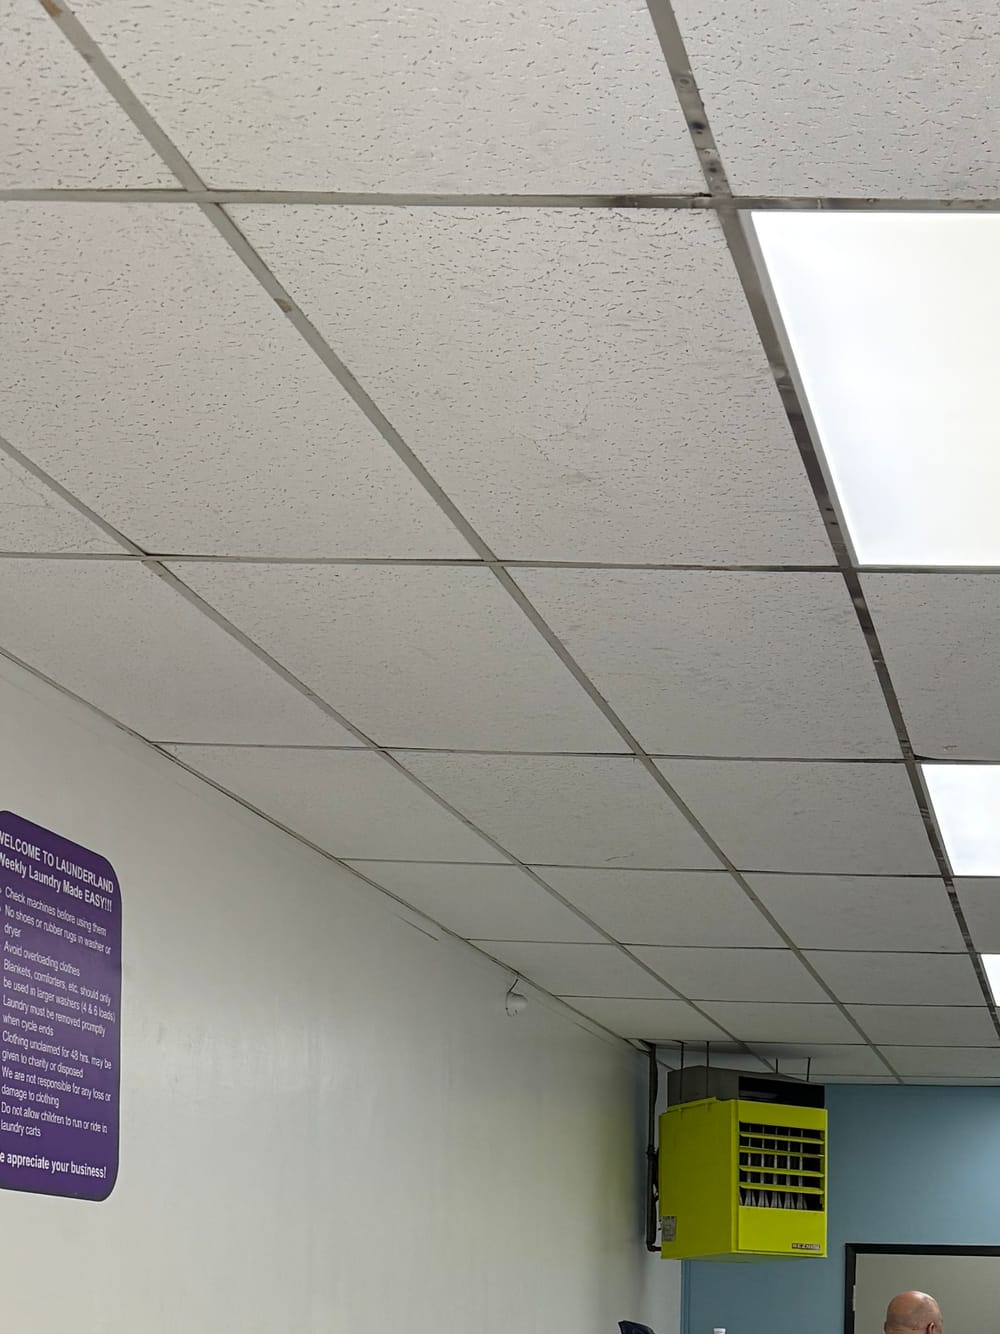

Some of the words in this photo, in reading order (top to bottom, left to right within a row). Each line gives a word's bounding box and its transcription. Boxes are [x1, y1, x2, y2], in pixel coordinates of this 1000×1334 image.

[28, 864, 61, 893] Laundry
[63, 879, 83, 900] Made
[84, 889, 112, 912] EASY!!!
[42, 850, 54, 867] TO
[56, 856, 114, 893] LAUNDERLAND
[5, 886, 26, 904] Check
[26, 897, 56, 916] machines
[56, 907, 76, 924] before
[76, 917, 92, 933] using
[92, 922, 106, 936] them
[4, 923, 21, 938] dryer
[5, 904, 14, 918] No
[16, 911, 34, 926] shoes
[36, 919, 42, 928] or
[43, 921, 62, 936] rubber
[64, 929, 76, 943] rugs
[78, 935, 84, 944] in
[84, 938, 104, 952] washer
[105, 945, 112, 954] or
[4, 940, 22, 957] Avoid
[24, 949, 58, 972] overloading
[60, 961, 80, 977] clothes
[4, 976, 12, 988] be
[14, 982, 28, 994] used
[30, 987, 36, 996] in
[37, 987, 54, 1003] larger
[56, 995, 80, 1010] washers
[80, 985, 98, 1000] should
[100, 994, 112, 1006] only
[3, 994, 28, 1014] Laundry
[30, 1005, 45, 1017] must
[46, 1008, 54, 1020] be
[56, 1012, 80, 1028] removed
[82, 1020, 106, 1038] promptly
[3, 1013, 20, 1027] when
[21, 1020, 38, 1032] cycle
[38, 1024, 54, 1036] ends
[2, 1030, 28, 1050] Clothing
[30, 1040, 60, 1056] unclaimed
[62, 1046, 70, 1058] for
[91, 1056, 104, 1069] may
[104, 1058, 112, 1070] be
[2, 1050, 19, 1062] given
[21, 1053, 27, 1064] to
[28, 1056, 49, 1072] charity
[50, 1063, 56, 1072] or
[57, 1062, 84, 1078] disposed
[2, 1065, 12, 1078] We
[14, 1071, 24, 1082] are
[26, 1074, 36, 1084] not
[38, 1078, 72, 1092] responsible
[72, 1082, 80, 1095] for
[81, 1087, 92, 1100] any
[93, 1088, 104, 1100] loss
[105, 1093, 112, 1102] or
[2, 1084, 27, 1101] damage
[28, 1089, 35, 1100] to
[36, 1091, 60, 1108] clothing
[0, 1120, 24, 1136] laundry
[26, 1126, 41, 1136] carts
[2, 1101, 10, 1114] Do
[12, 1106, 22, 1116] not
[24, 1106, 40, 1120] allow
[41, 1111, 64, 1124] children
[66, 1116, 72, 1126] to
[72, 1120, 82, 1128] run
[83, 1121, 90, 1130] or
[90, 1122, 102, 1132] ride
[102, 1125, 108, 1134] in
[7, 1153, 50, 1170] appreciate
[52, 1160, 70, 1174] your
[71, 1161, 106, 1178] business!
